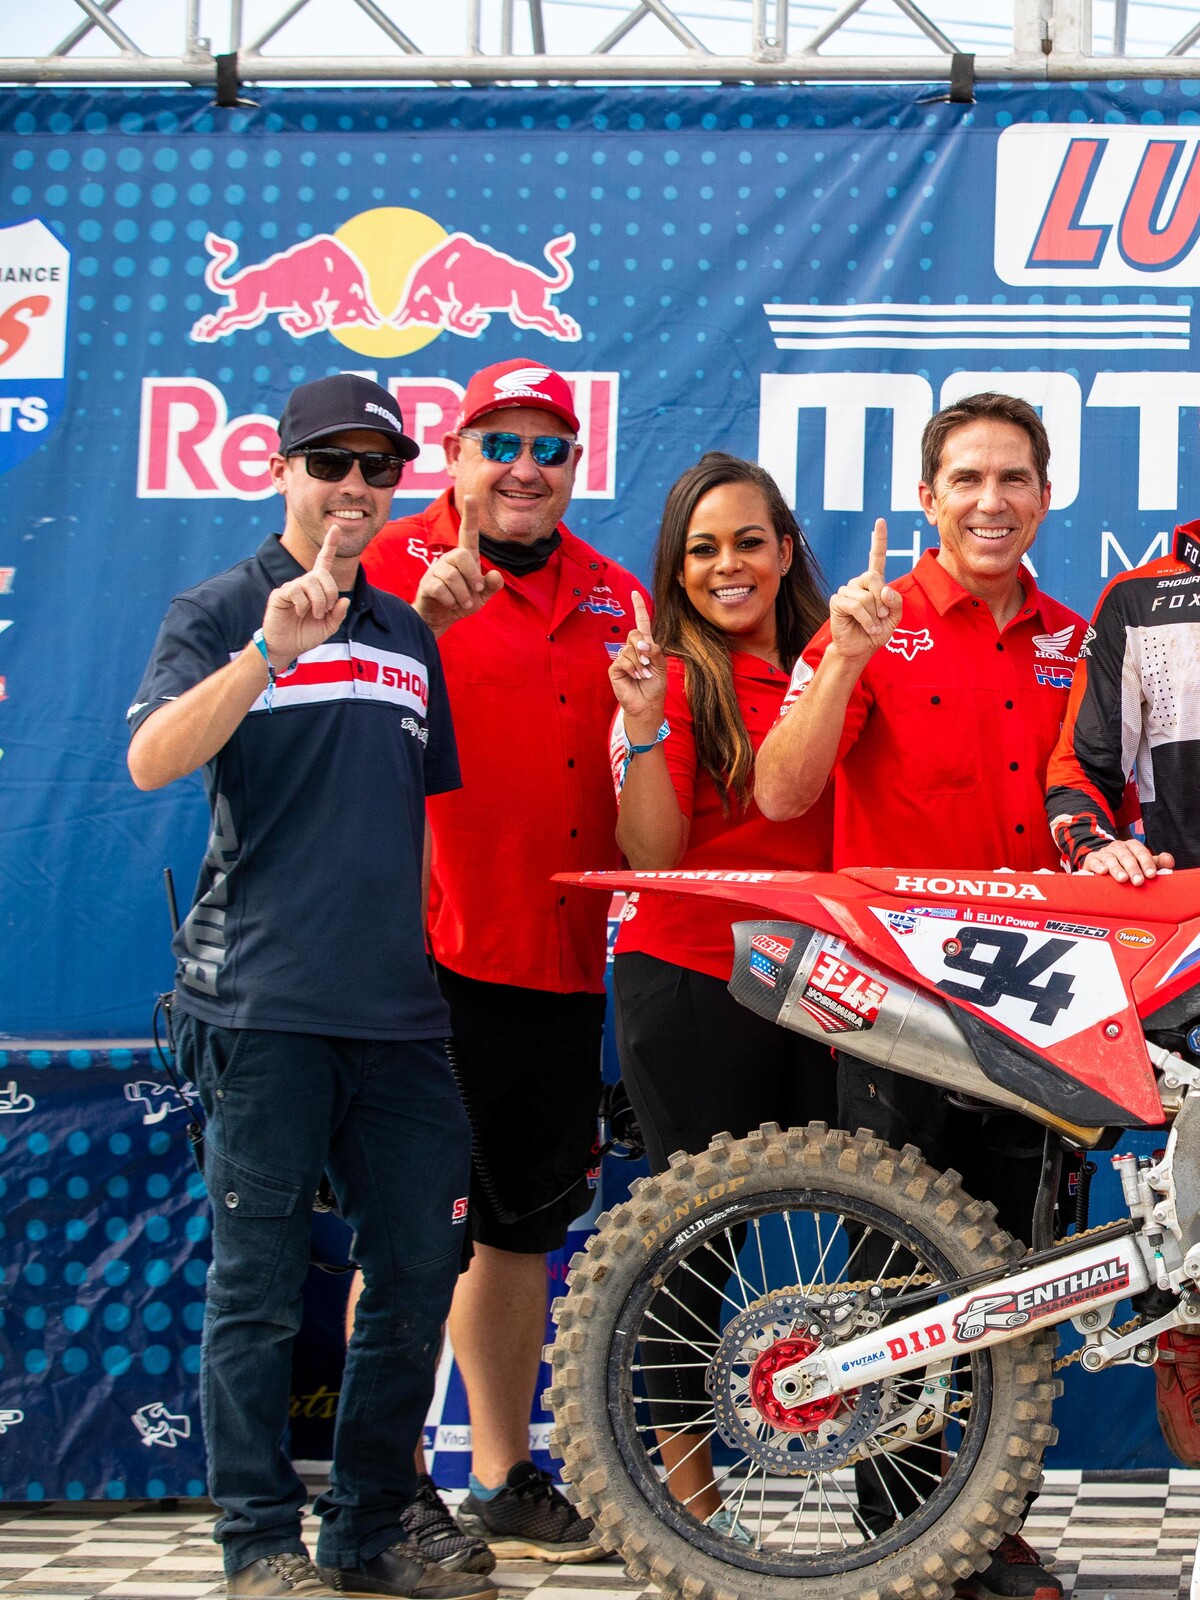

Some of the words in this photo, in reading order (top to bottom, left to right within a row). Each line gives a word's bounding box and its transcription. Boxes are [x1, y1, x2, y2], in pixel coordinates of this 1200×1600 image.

[137, 371, 378, 501] Re
[1157, 576, 1200, 589] SHOWA
[1034, 664, 1075, 689] HR
[894, 875, 1047, 901] HONDA
[1006, 917, 1040, 929] Power
[1118, 931, 1136, 943] Twin
[1137, 935, 1153, 944] Air
[810, 955, 887, 1017] ヨシムラ
[936, 926, 1079, 1027] 94
[805, 986, 864, 1028] YOSHIMURA
[641, 1176, 746, 1251] DUNLOP
[850, 1350, 886, 1368] YUTAKA
